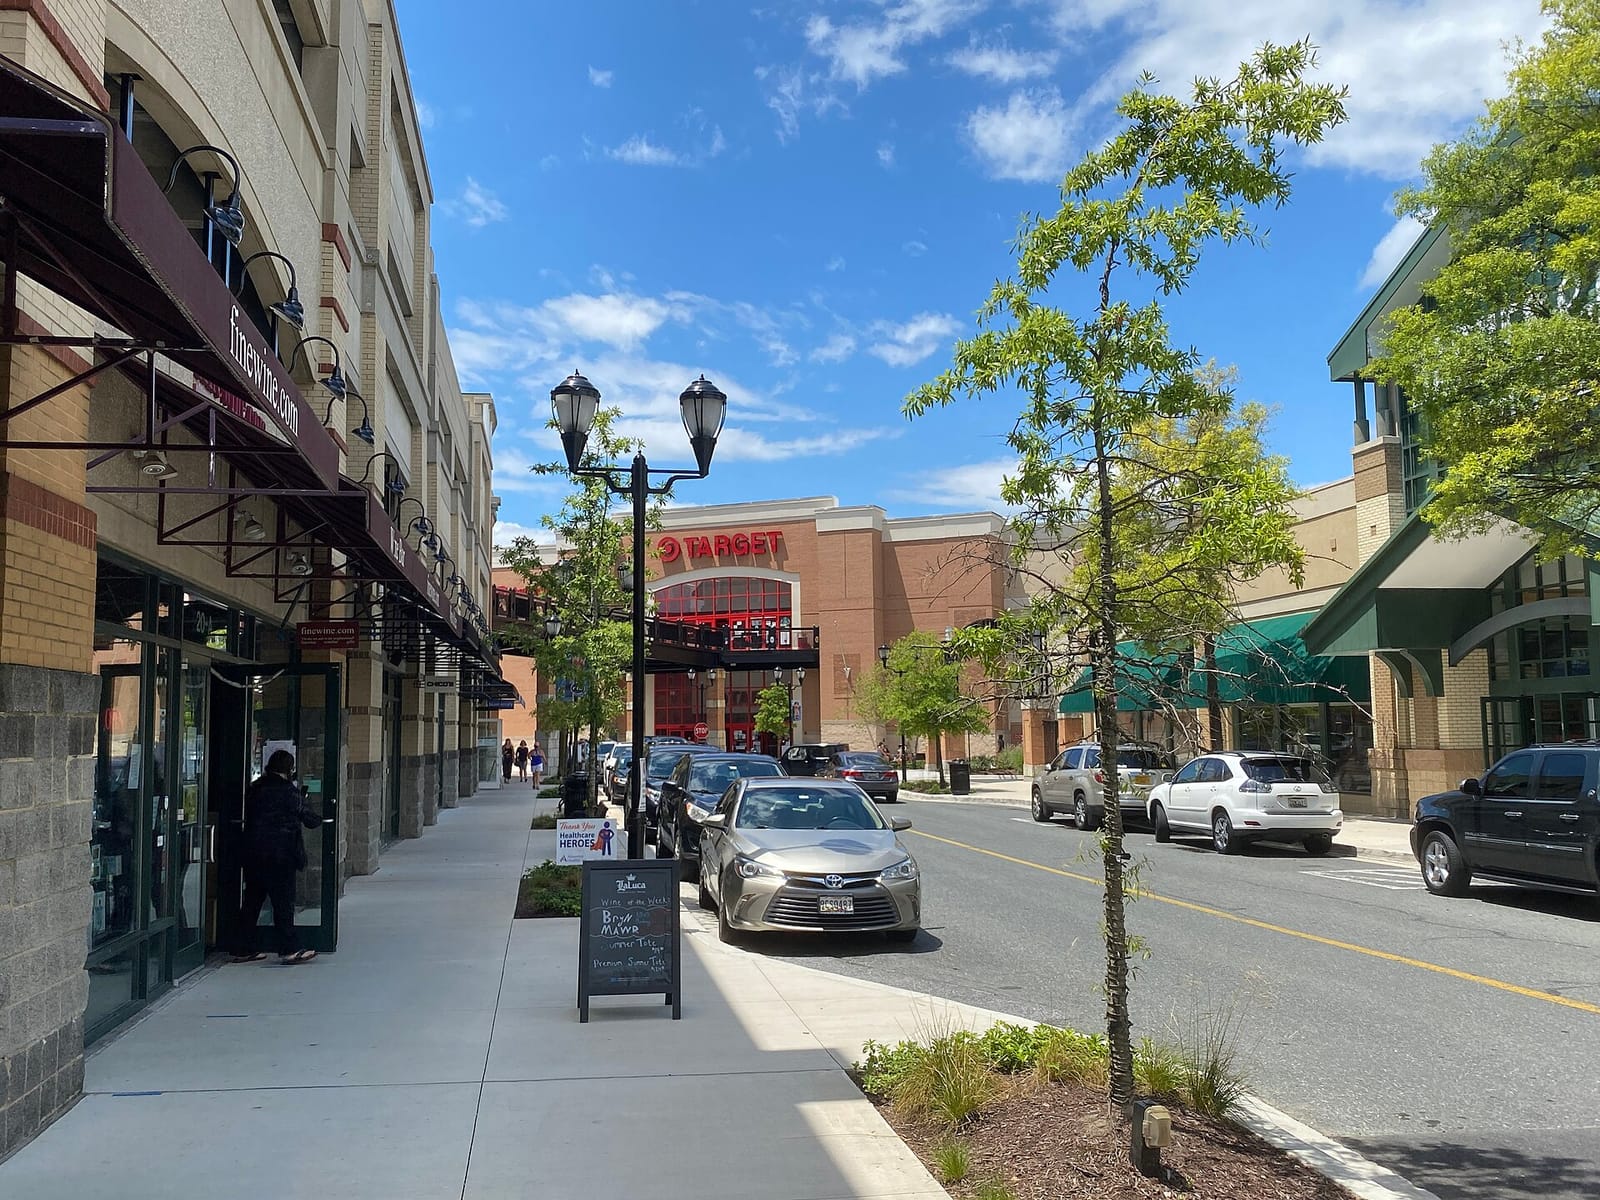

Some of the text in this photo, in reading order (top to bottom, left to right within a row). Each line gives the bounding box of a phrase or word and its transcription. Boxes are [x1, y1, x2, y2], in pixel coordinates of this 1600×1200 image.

[229, 305, 300, 437] finewine.com
[683, 531, 784, 558] TARGET
[301, 627, 355, 635] finewine.com
[695, 727, 708, 735] STOP
[559, 821, 596, 832] Thank You
[559, 839, 595, 848] HEROES
[601, 898, 621, 906] Wine
